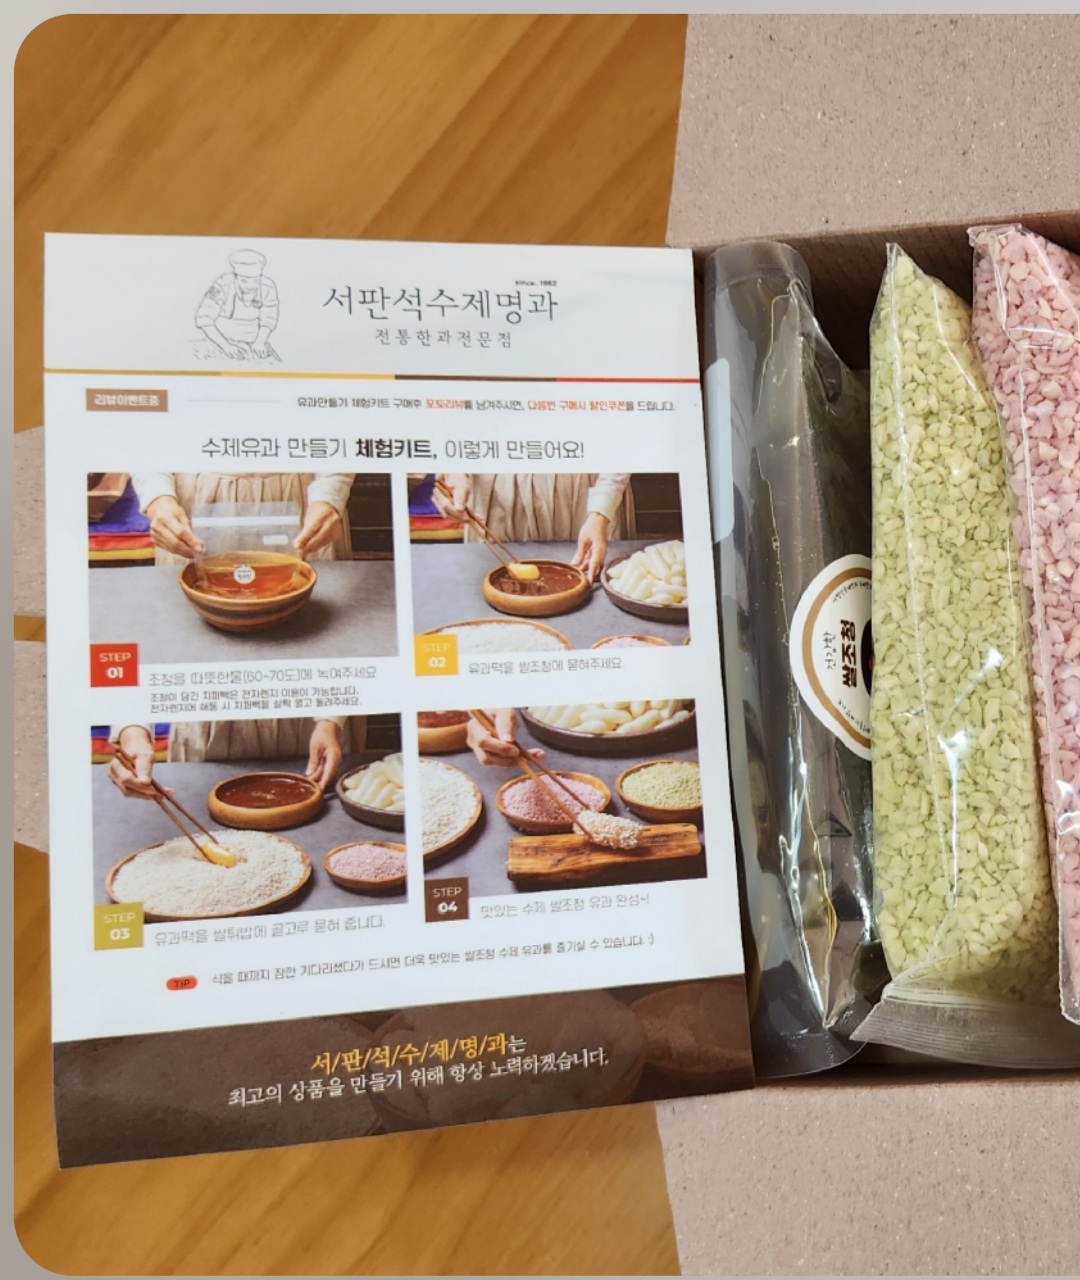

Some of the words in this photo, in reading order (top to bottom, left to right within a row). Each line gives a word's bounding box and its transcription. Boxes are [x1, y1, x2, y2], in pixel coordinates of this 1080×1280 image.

[322, 285, 559, 325] 서판석수제명과
[375, 328, 512, 349] 전통한과전문점
[201, 437, 281, 458] 수제유과
[288, 438, 347, 459] 만들기
[355, 438, 437, 460] 체험키트,
[445, 440, 499, 460] 이렇게
[507, 440, 585, 460] 만들어요!
[423, 643, 451, 653] STEP
[840, 619, 857, 689] 쌀조청
[99, 652, 132, 663] STEP
[428, 657, 447, 668] 02
[106, 666, 124, 679] 01
[149, 672, 186, 687] 조청을
[433, 887, 463, 897] STEP
[437, 901, 458, 914] 04
[104, 912, 136, 923] STEP
[109, 928, 130, 941] 03
[310, 1032, 527, 1076] 서/판/석/수/제/명/과는
[228, 1083, 282, 1107] 최고의
[288, 1077, 345, 1102] 상품을
[350, 1069, 402, 1094] 만들기
[409, 1065, 444, 1087] 위해
[450, 1061, 485, 1083] 항상
[490, 1047, 609, 1077] 노력하겠습니다.
